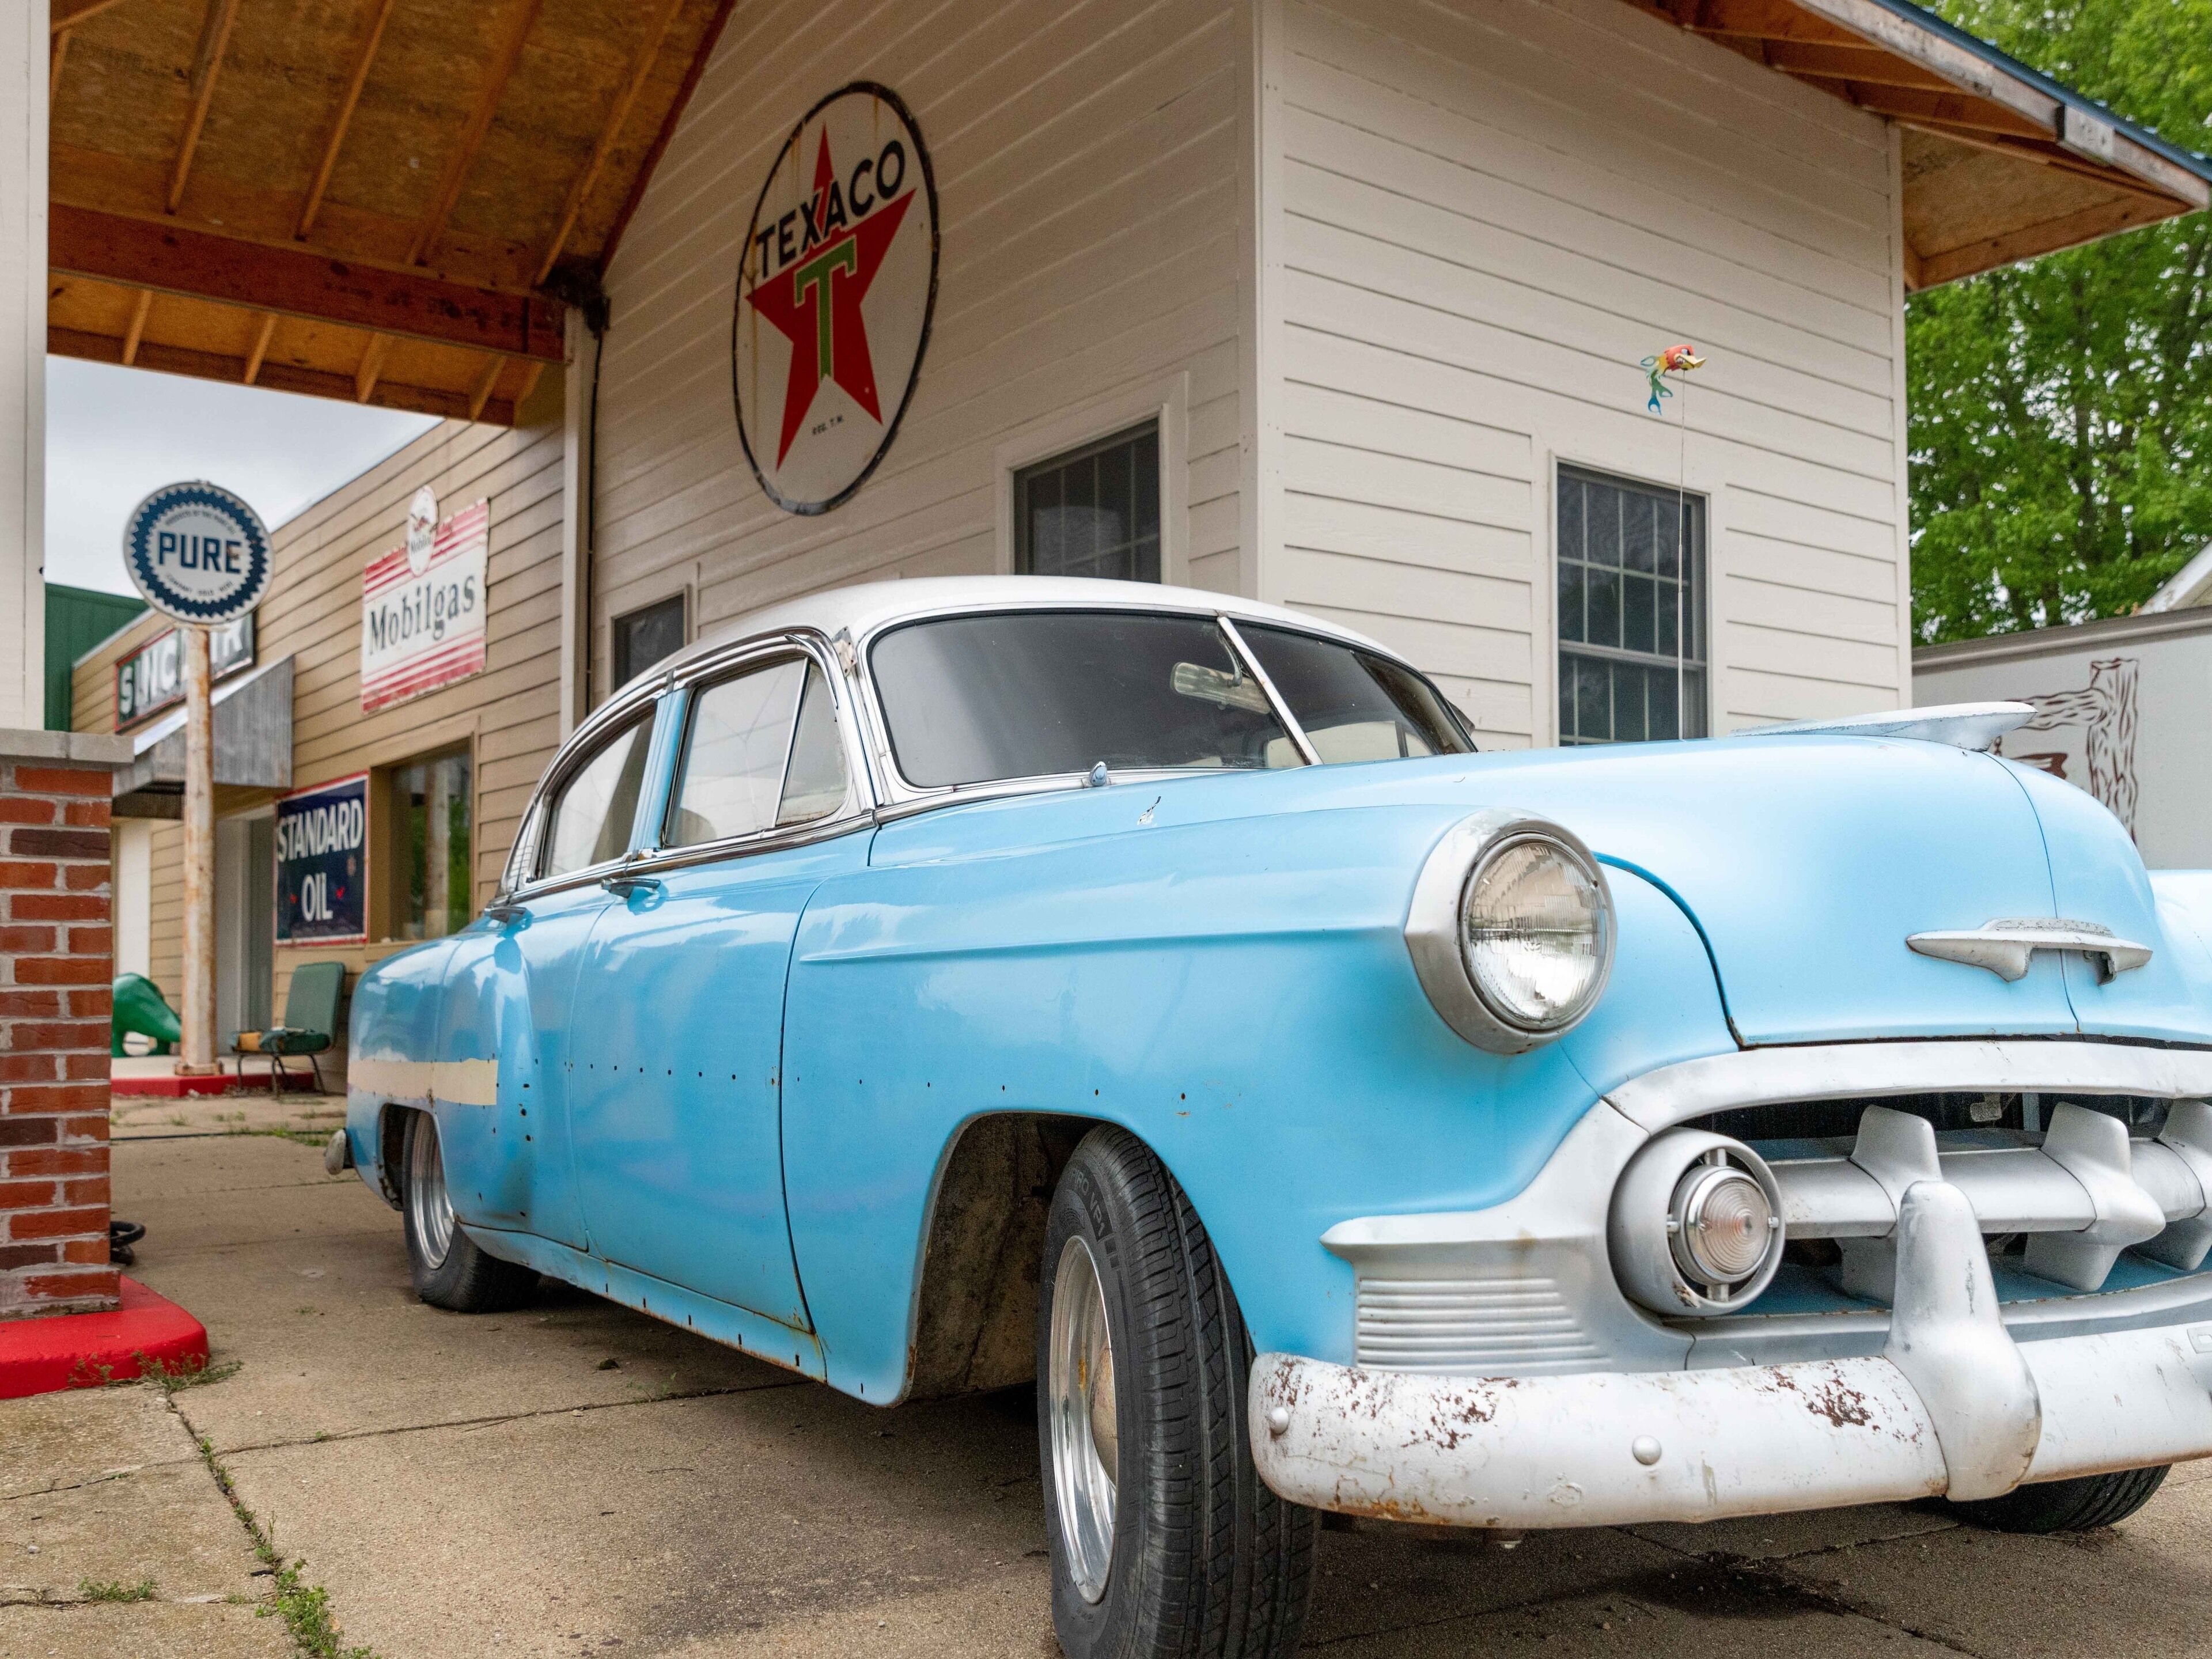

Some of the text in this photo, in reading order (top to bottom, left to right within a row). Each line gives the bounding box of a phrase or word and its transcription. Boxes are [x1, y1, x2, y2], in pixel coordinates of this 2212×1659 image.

[756, 139, 905, 278] TEXACO
[794, 234, 857, 381] T
[159, 532, 241, 574] PURE
[368, 575, 475, 657] Mobilgas
[277, 798, 363, 863] STANDARD
[301, 872, 334, 922] OIL
